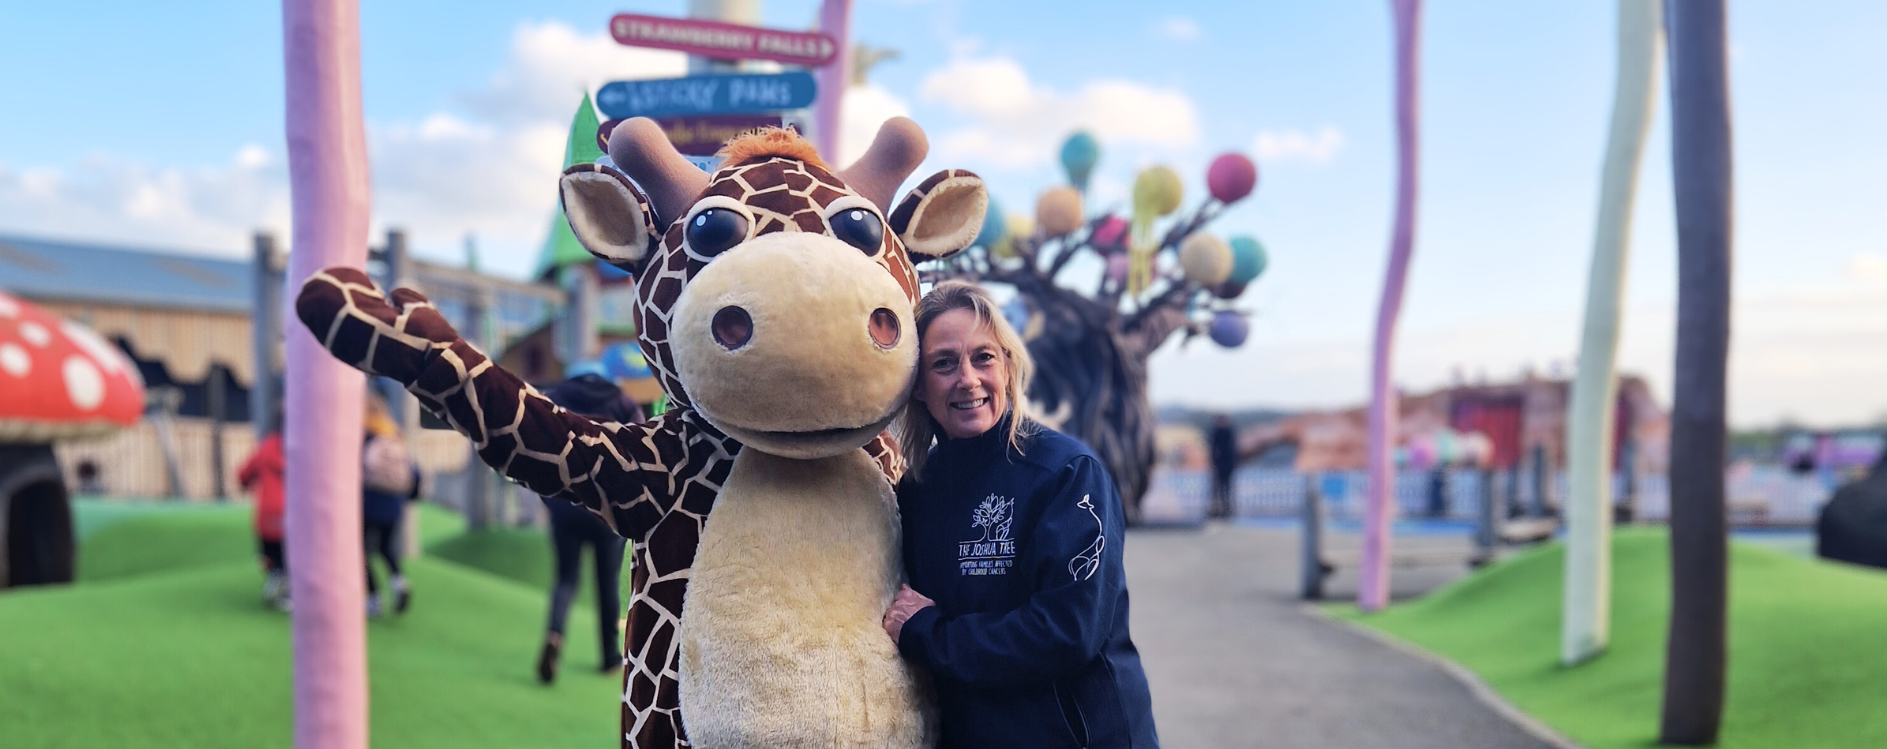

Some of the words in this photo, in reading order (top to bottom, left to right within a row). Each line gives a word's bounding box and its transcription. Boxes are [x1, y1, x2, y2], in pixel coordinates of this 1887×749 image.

[615, 21, 751, 49] STRAWBERRY
[758, 36, 816, 57] FALLS
[958, 544, 970, 556] THE
[971, 542, 997, 556] JOSHUA
[1000, 542, 1016, 554] TREE
